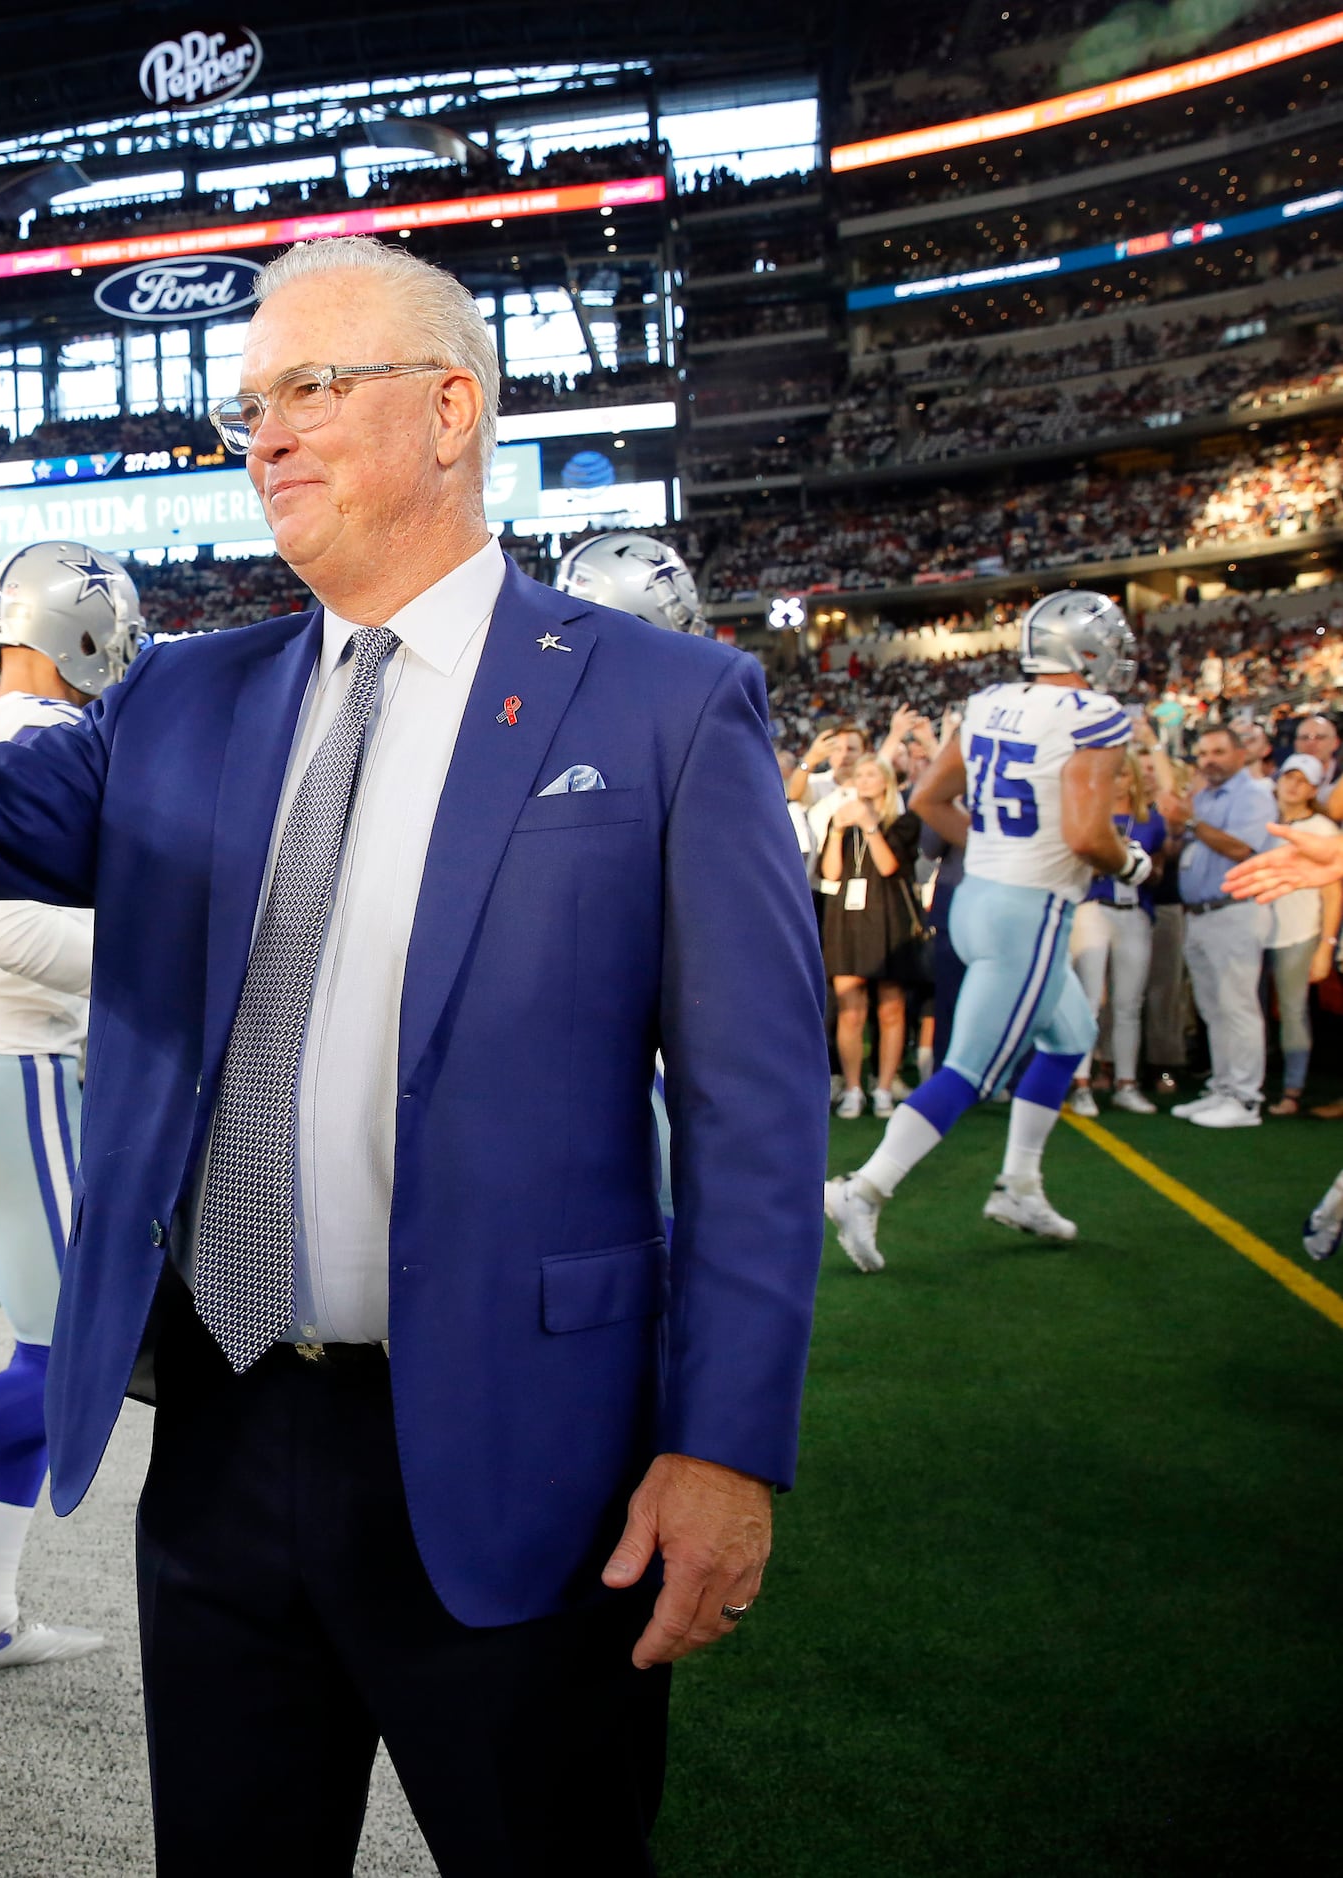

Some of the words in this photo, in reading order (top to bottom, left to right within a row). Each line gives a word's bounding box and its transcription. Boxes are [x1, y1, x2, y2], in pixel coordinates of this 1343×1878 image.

[140, 41, 254, 104] Pepper
[180, 31, 227, 67] Dr
[129, 264, 237, 314] Ford
[157, 489, 262, 528] POWERE
[968, 734, 1039, 837] 75
